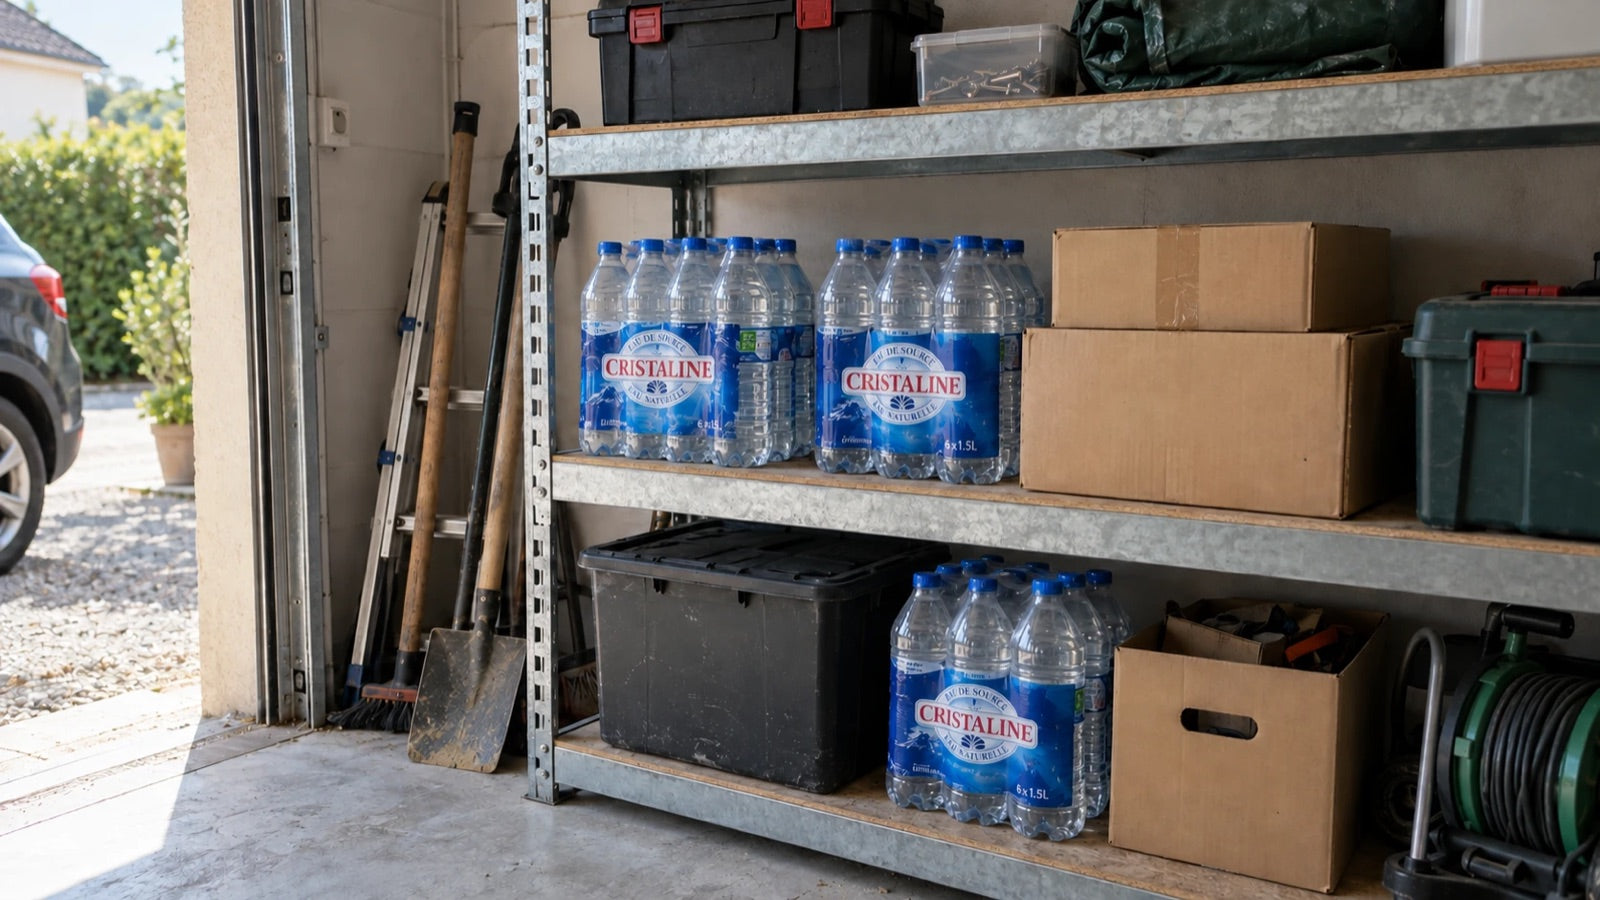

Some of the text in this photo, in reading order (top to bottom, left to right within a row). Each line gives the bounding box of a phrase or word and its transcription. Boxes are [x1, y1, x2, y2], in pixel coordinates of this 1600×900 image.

[643, 334, 656, 343] DE
[886, 346, 899, 356] DE
[900, 347, 936, 367] SOURCE
[605, 358, 712, 379] CRISTALINE
[846, 372, 961, 395] CRISTALINE
[888, 403, 938, 421] NATURELLE
[958, 687, 971, 696] DE
[972, 688, 1008, 711] SOURCE
[919, 704, 1033, 743] CRISTALINE
[959, 745, 1009, 761] NATURELLE
